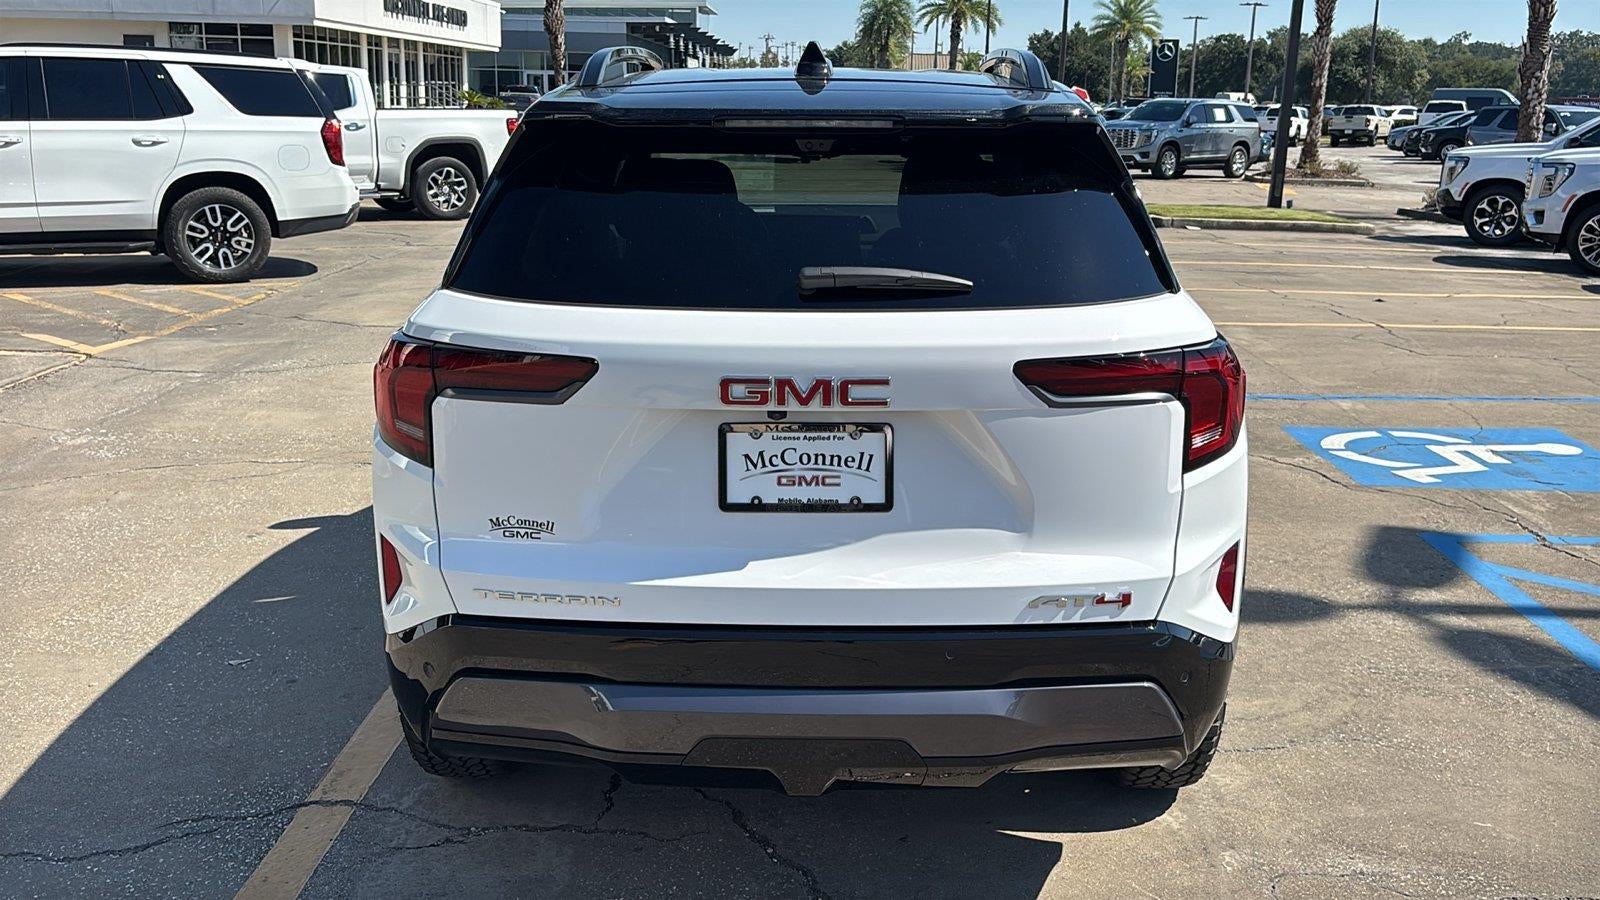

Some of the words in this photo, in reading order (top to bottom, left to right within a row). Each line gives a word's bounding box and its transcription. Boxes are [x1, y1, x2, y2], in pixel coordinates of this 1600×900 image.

[719, 375, 892, 408] GMC
[802, 434, 831, 442] Applied
[742, 447, 875, 473] McConnell
[776, 474, 842, 488] GMC
[488, 515, 555, 533] McConnell
[502, 530, 542, 540] GMC
[472, 588, 622, 608] TERRAIN
[1028, 591, 1133, 609] AT4
